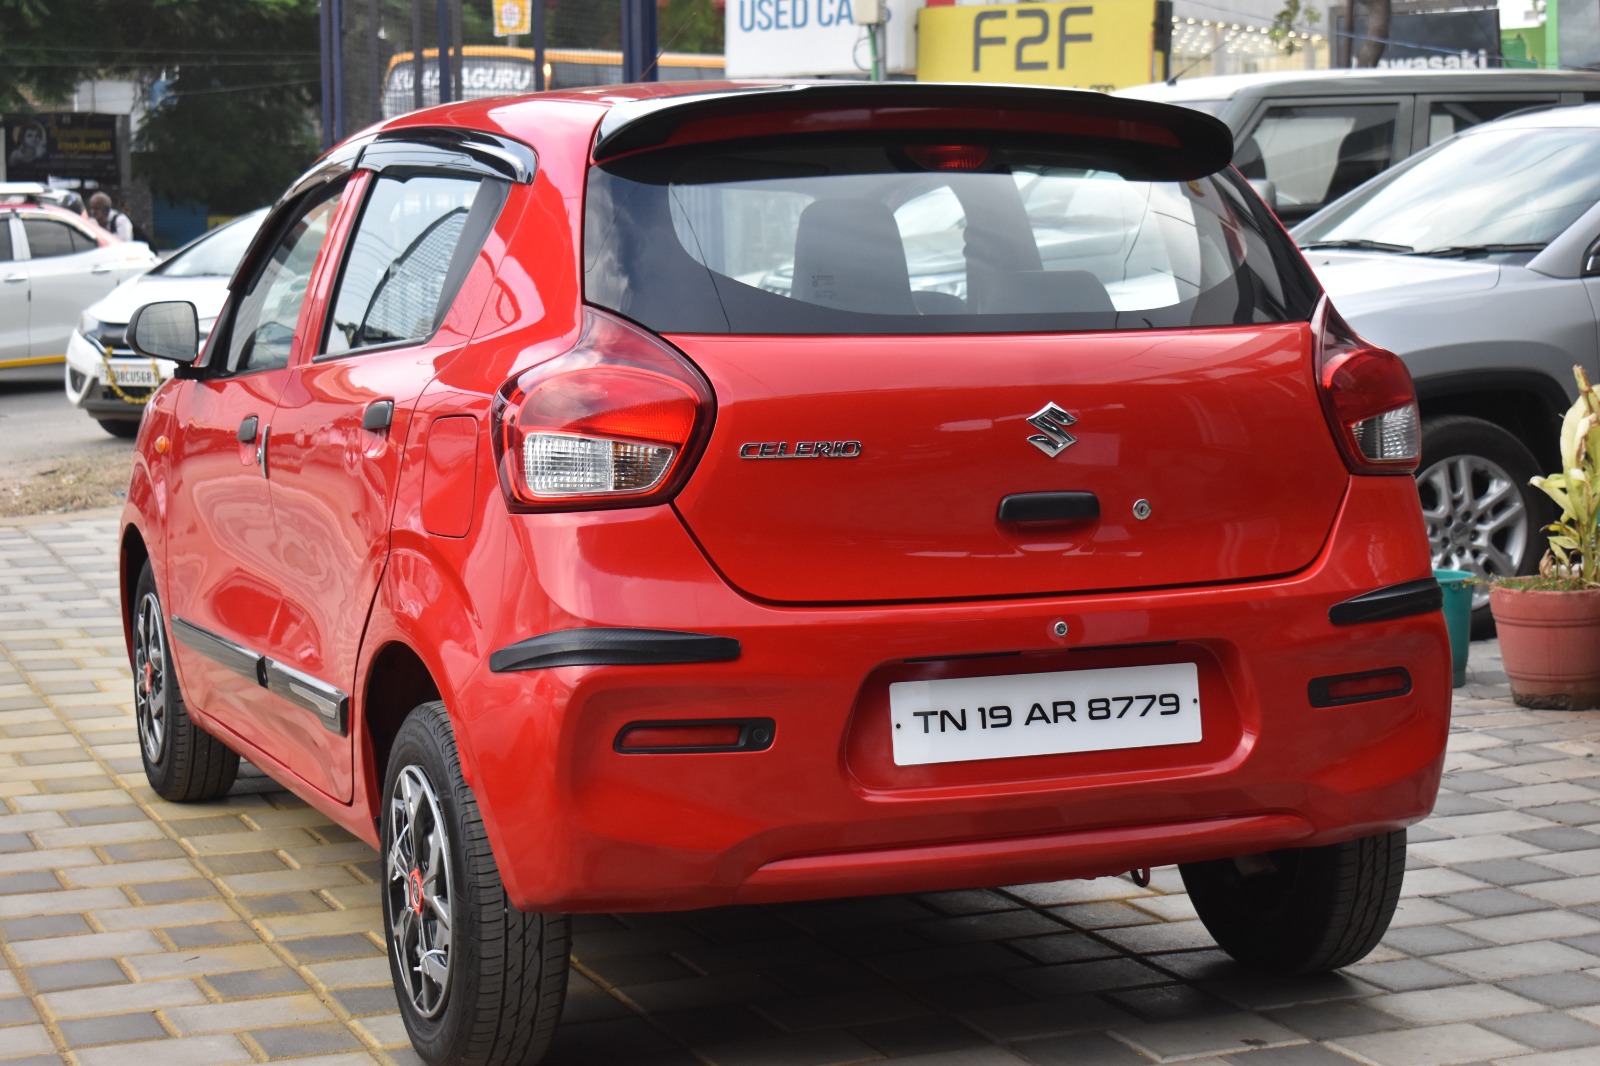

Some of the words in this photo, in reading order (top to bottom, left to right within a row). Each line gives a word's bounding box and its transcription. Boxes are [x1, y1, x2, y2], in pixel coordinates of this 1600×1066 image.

[739, 0, 808, 32] USED
[817, 0, 892, 27] CA
[972, 6, 1093, 73] F2F
[1352, 48, 1487, 69] awasaki
[392, 66, 531, 90] KUMAAGURU
[739, 440, 862, 459] CELERIO
[912, 708, 967, 734] TN
[977, 705, 1013, 730] 19
[1024, 700, 1077, 726] AR
[1087, 693, 1181, 721] 8779
